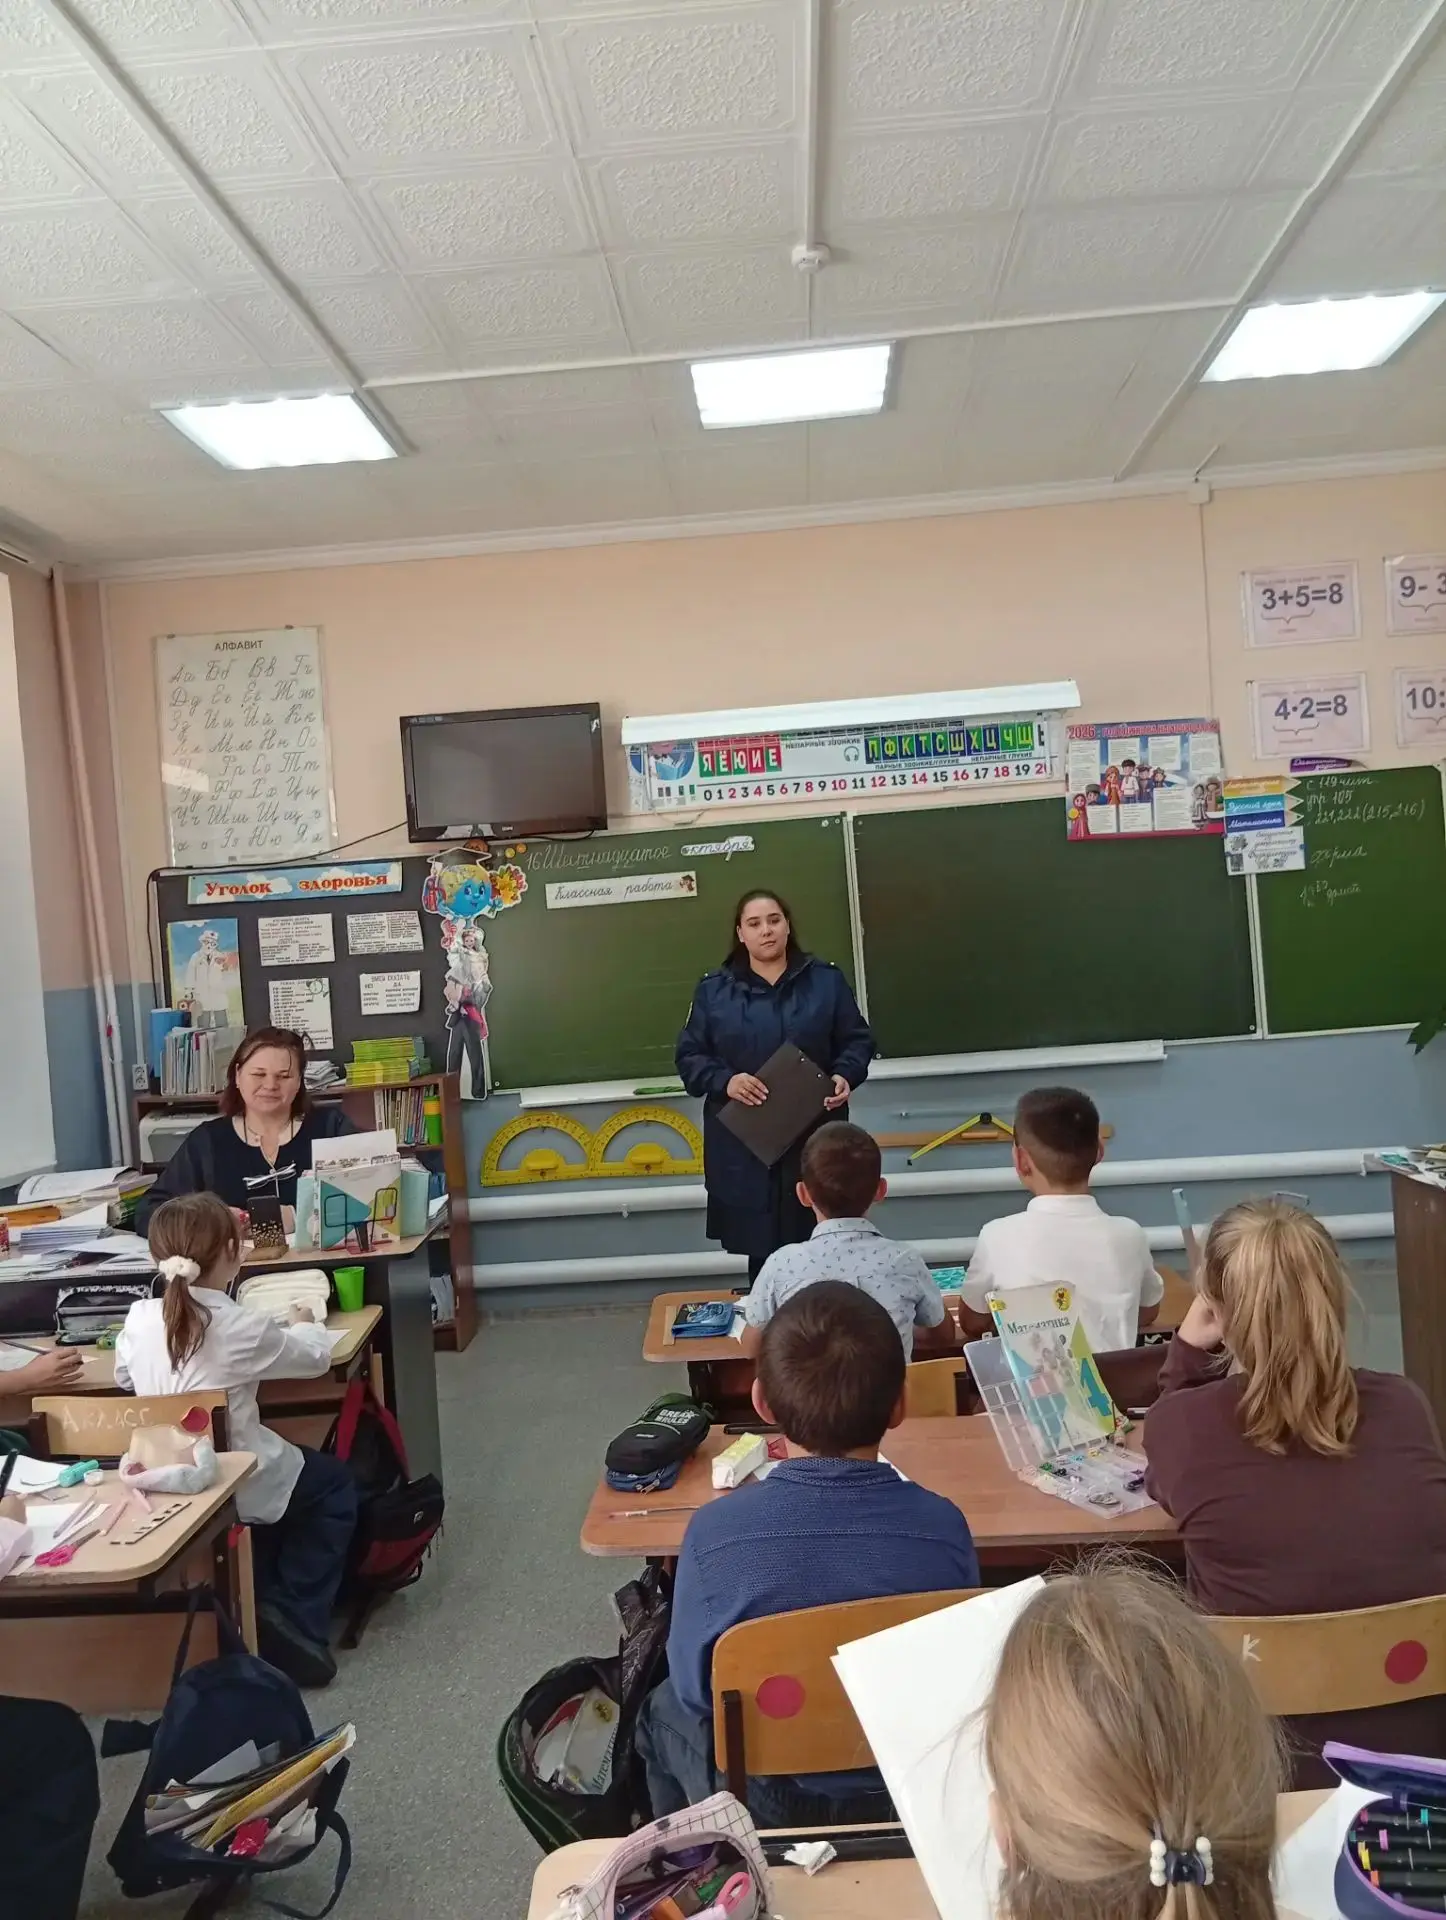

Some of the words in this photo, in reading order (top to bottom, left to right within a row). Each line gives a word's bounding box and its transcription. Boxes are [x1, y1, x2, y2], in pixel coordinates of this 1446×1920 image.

[1262, 582, 1344, 610] 3+5=8
[214, 640, 264, 651] АЛФАВИТ
[704, 790, 712, 801] 0
[716, 789, 724, 800] 1
[728, 788, 736, 799] 2
[741, 787, 750, 798] 3
[753, 786, 762, 797] 4
[767, 785, 775, 796] 5
[780, 784, 788, 794] 6
[793, 783, 800, 794] 7
[806, 782, 814, 792] 8
[818, 780, 826, 792] 9
[832, 779, 847, 790] 10
[852, 778, 866, 789] 11
[871, 776, 886, 788] 12
[892, 774, 907, 786] 13
[912, 773, 928, 785] 14
[932, 772, 948, 782] 15
[953, 770, 970, 782] 16
[974, 768, 988, 780] 17
[994, 766, 1010, 778] 18
[1015, 764, 1030, 776] 19
[205, 882, 272, 896] Уголок
[298, 874, 388, 893] здоровья
[554, 886, 612, 900] Классная
[624, 878, 672, 899] работа
